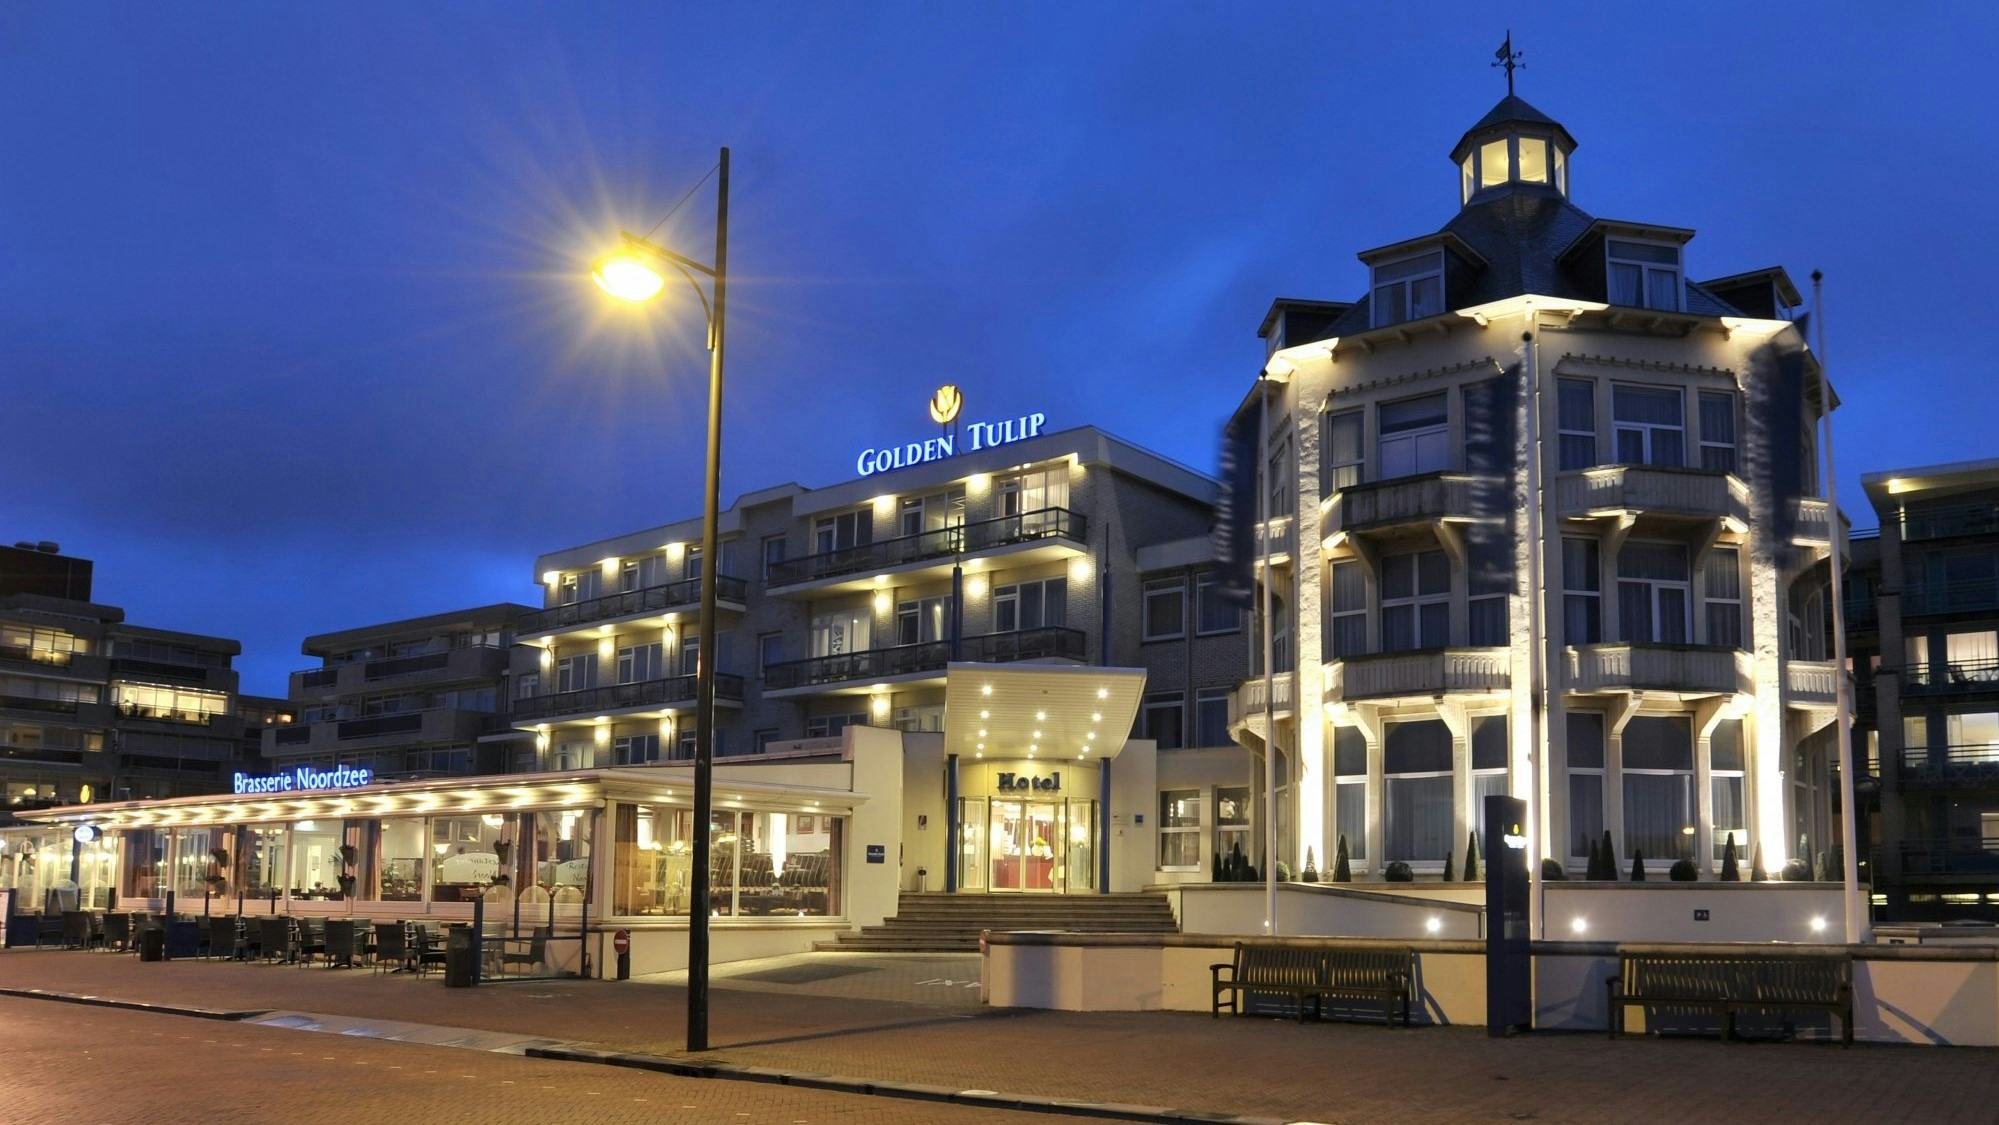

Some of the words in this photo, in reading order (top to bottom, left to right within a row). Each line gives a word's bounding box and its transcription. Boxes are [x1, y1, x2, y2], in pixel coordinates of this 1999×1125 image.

[234, 772, 292, 794] Brasserie
[297, 764, 368, 790] Noordzee
[997, 771, 1062, 791] Hotel
